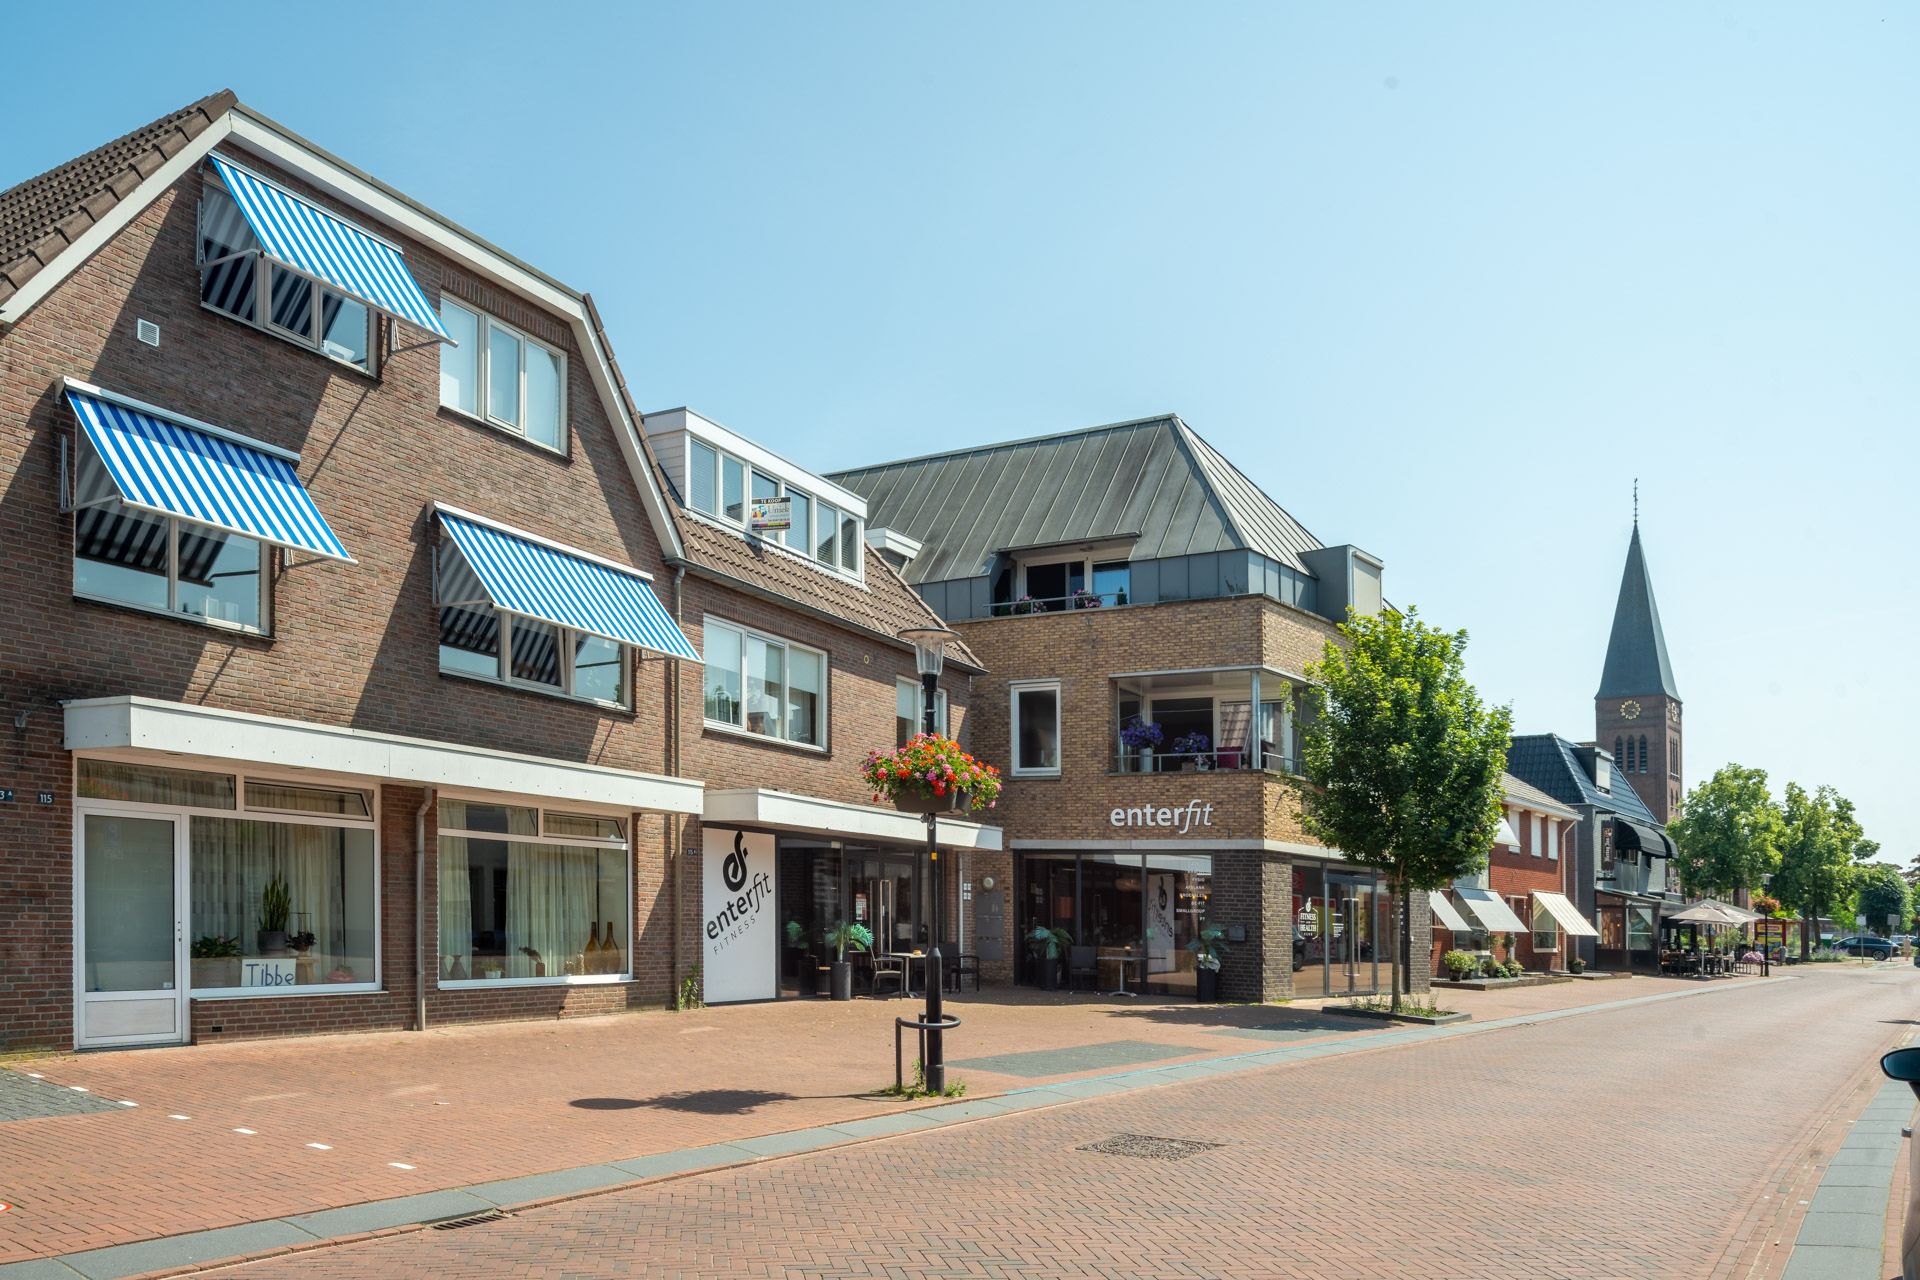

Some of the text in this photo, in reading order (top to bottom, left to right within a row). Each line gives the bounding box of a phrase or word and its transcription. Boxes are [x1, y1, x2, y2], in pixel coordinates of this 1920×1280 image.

[39, 793, 53, 803] 115
[1110, 799, 1214, 834] enterfit
[706, 872, 772, 940] enterfit
[1300, 912, 1317, 921] FITNESS
[713, 915, 756, 955] FITNESS
[1299, 924, 1317, 932] HEALTH
[245, 963, 295, 986] Tibbe
